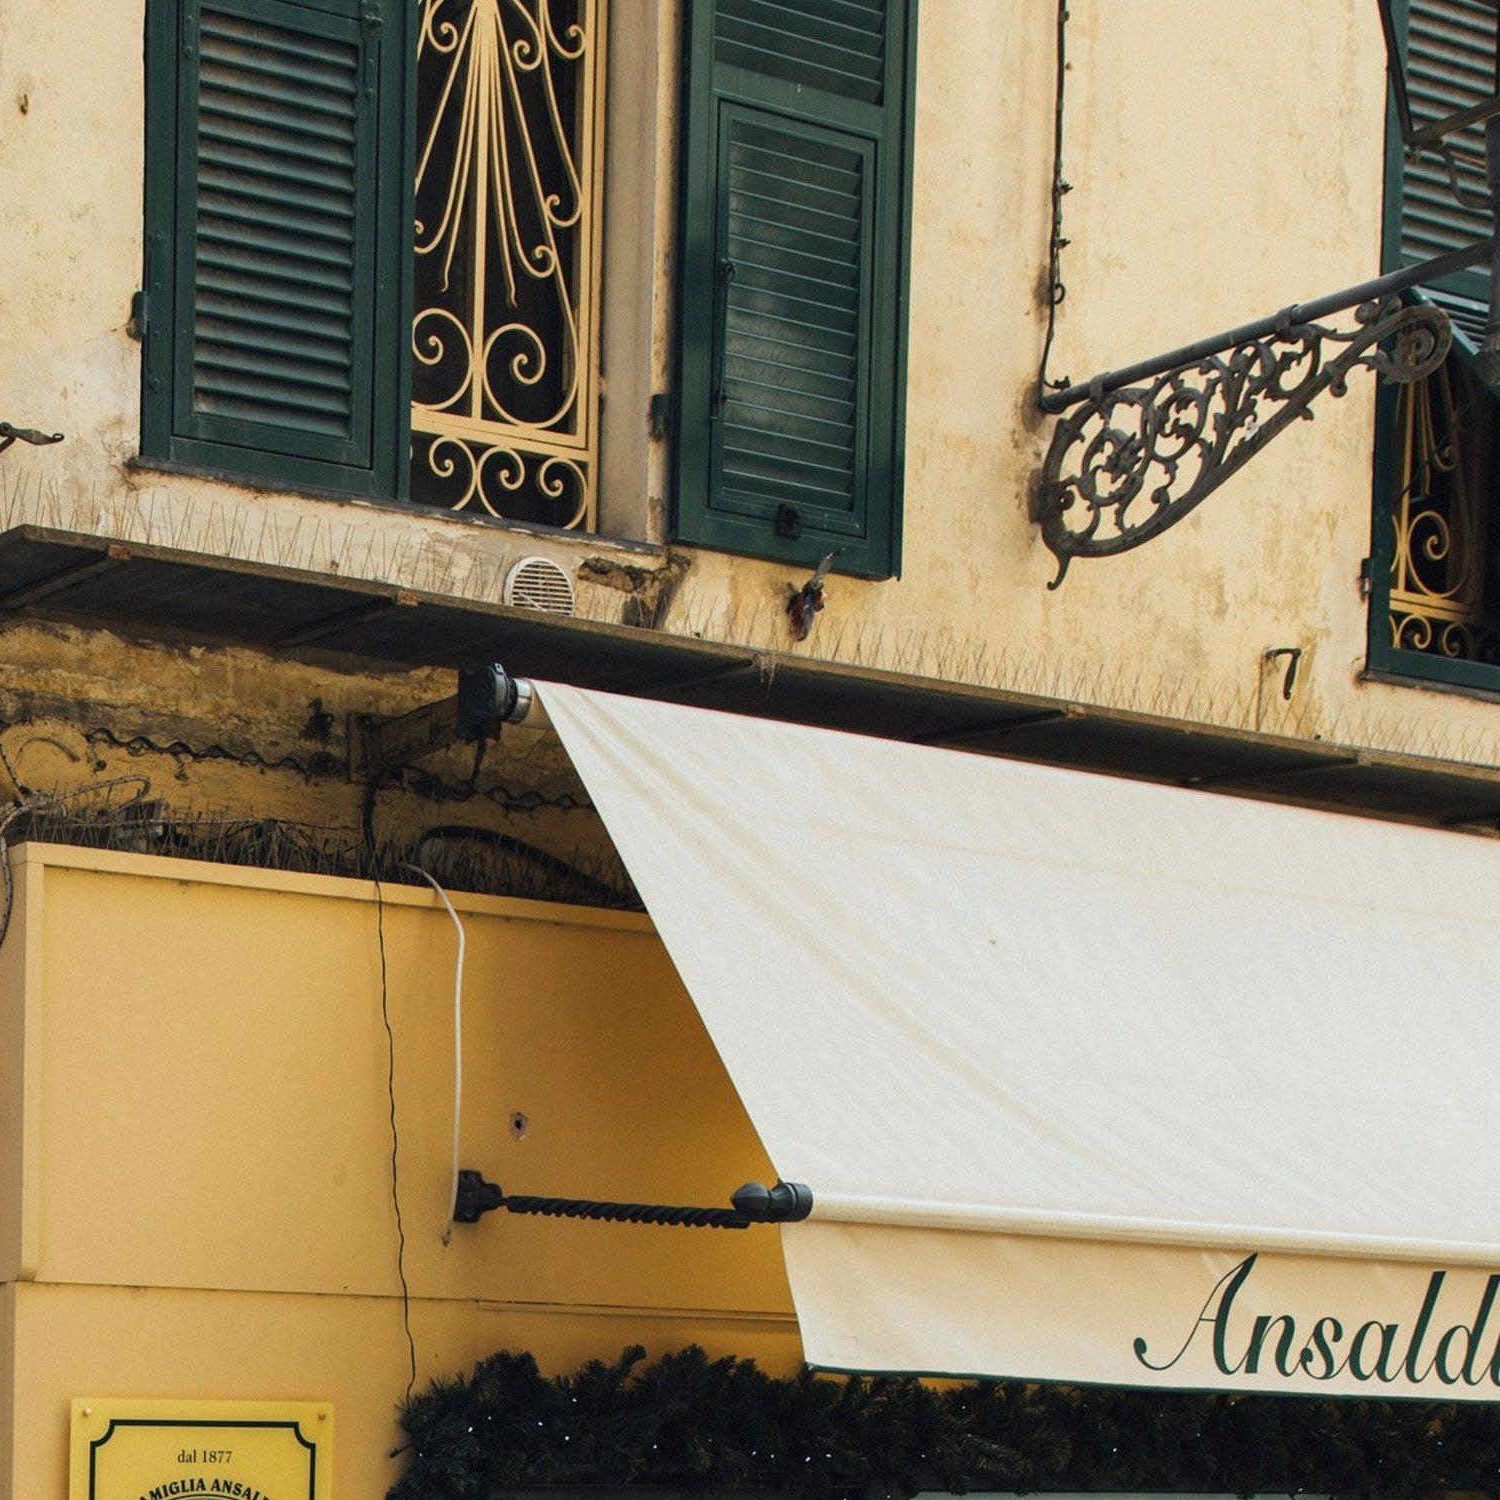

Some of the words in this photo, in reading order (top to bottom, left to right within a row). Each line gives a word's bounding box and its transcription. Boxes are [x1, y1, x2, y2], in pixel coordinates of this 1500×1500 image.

[1133, 1252, 1500, 1386] Ansald
[177, 1450, 197, 1463] dal
[202, 1450, 232, 1464] 1877
